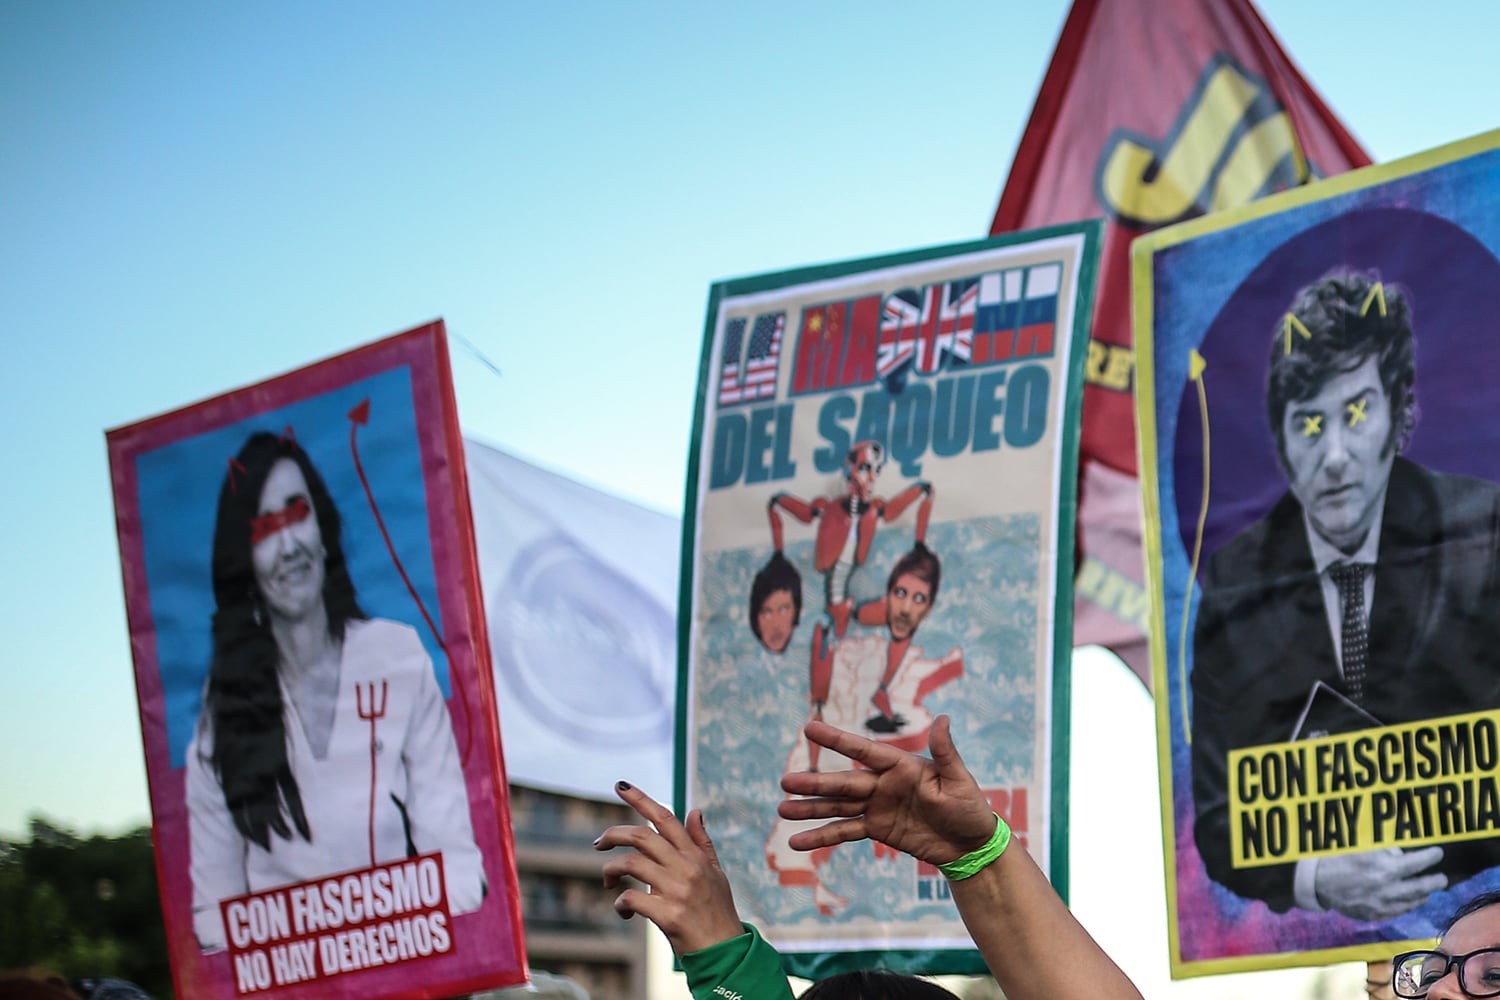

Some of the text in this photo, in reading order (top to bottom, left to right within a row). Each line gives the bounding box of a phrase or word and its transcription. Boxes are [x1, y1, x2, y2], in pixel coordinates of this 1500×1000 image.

[717, 309, 787, 410] LA
[709, 363, 1051, 491] DEL SAQUEO
[1237, 718, 1500, 805] CON FASCISMO
[1240, 806, 1289, 860] NO
[1297, 795, 1363, 854] HAY
[226, 857, 442, 949] CON FASCISMO
[234, 911, 453, 994] NO HAY DERECHOS
